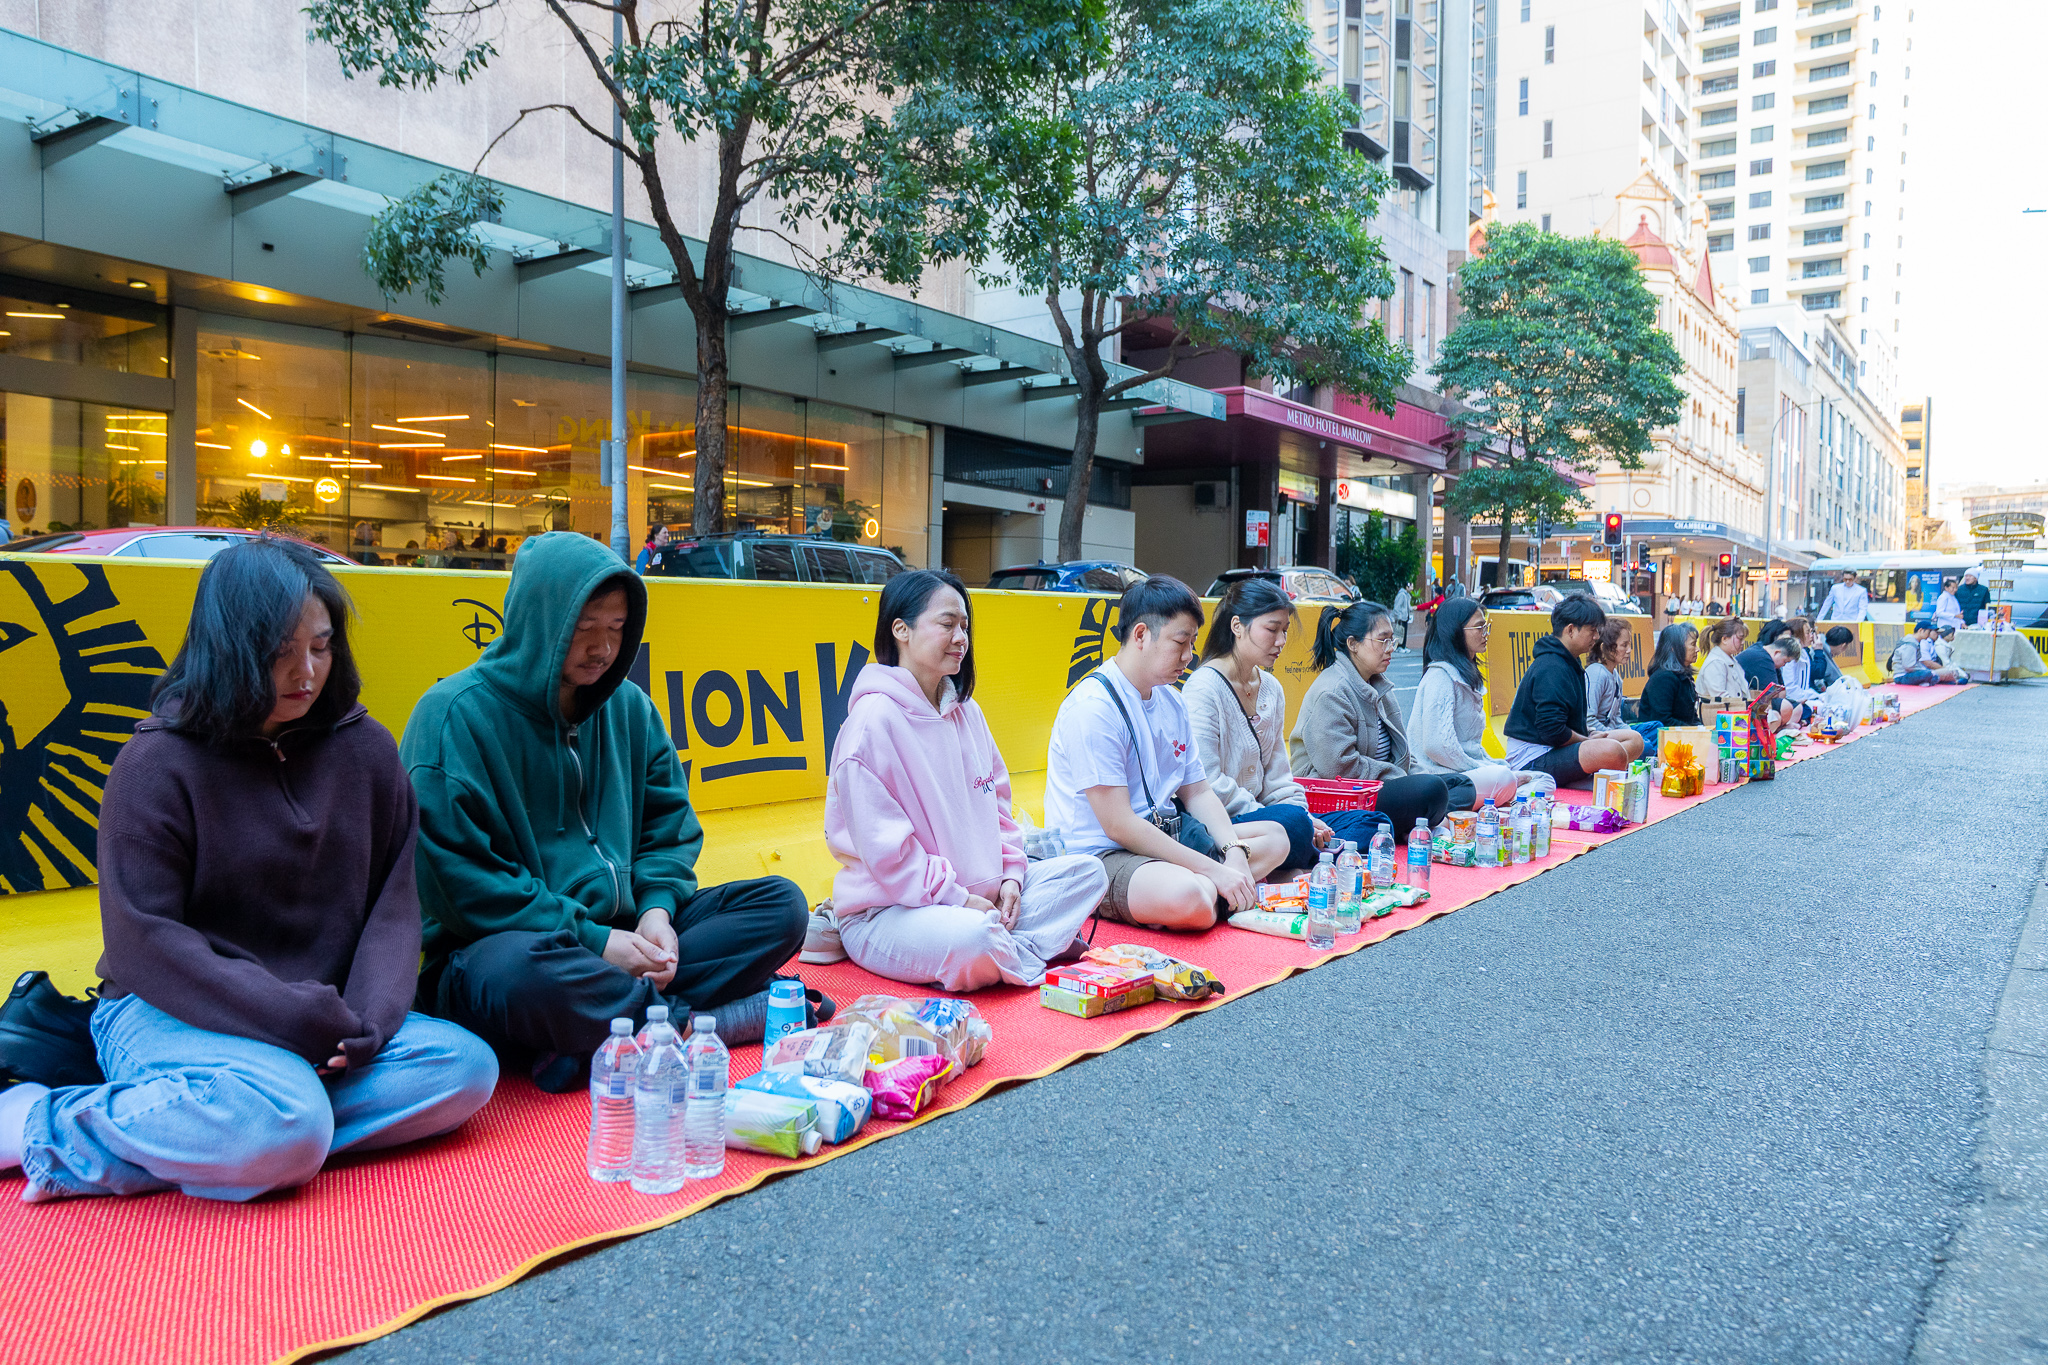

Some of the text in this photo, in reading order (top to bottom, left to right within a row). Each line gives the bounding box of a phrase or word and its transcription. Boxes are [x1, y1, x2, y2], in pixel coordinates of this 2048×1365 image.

[1287, 409, 1372, 445] METRO HOTEL MARLOW
